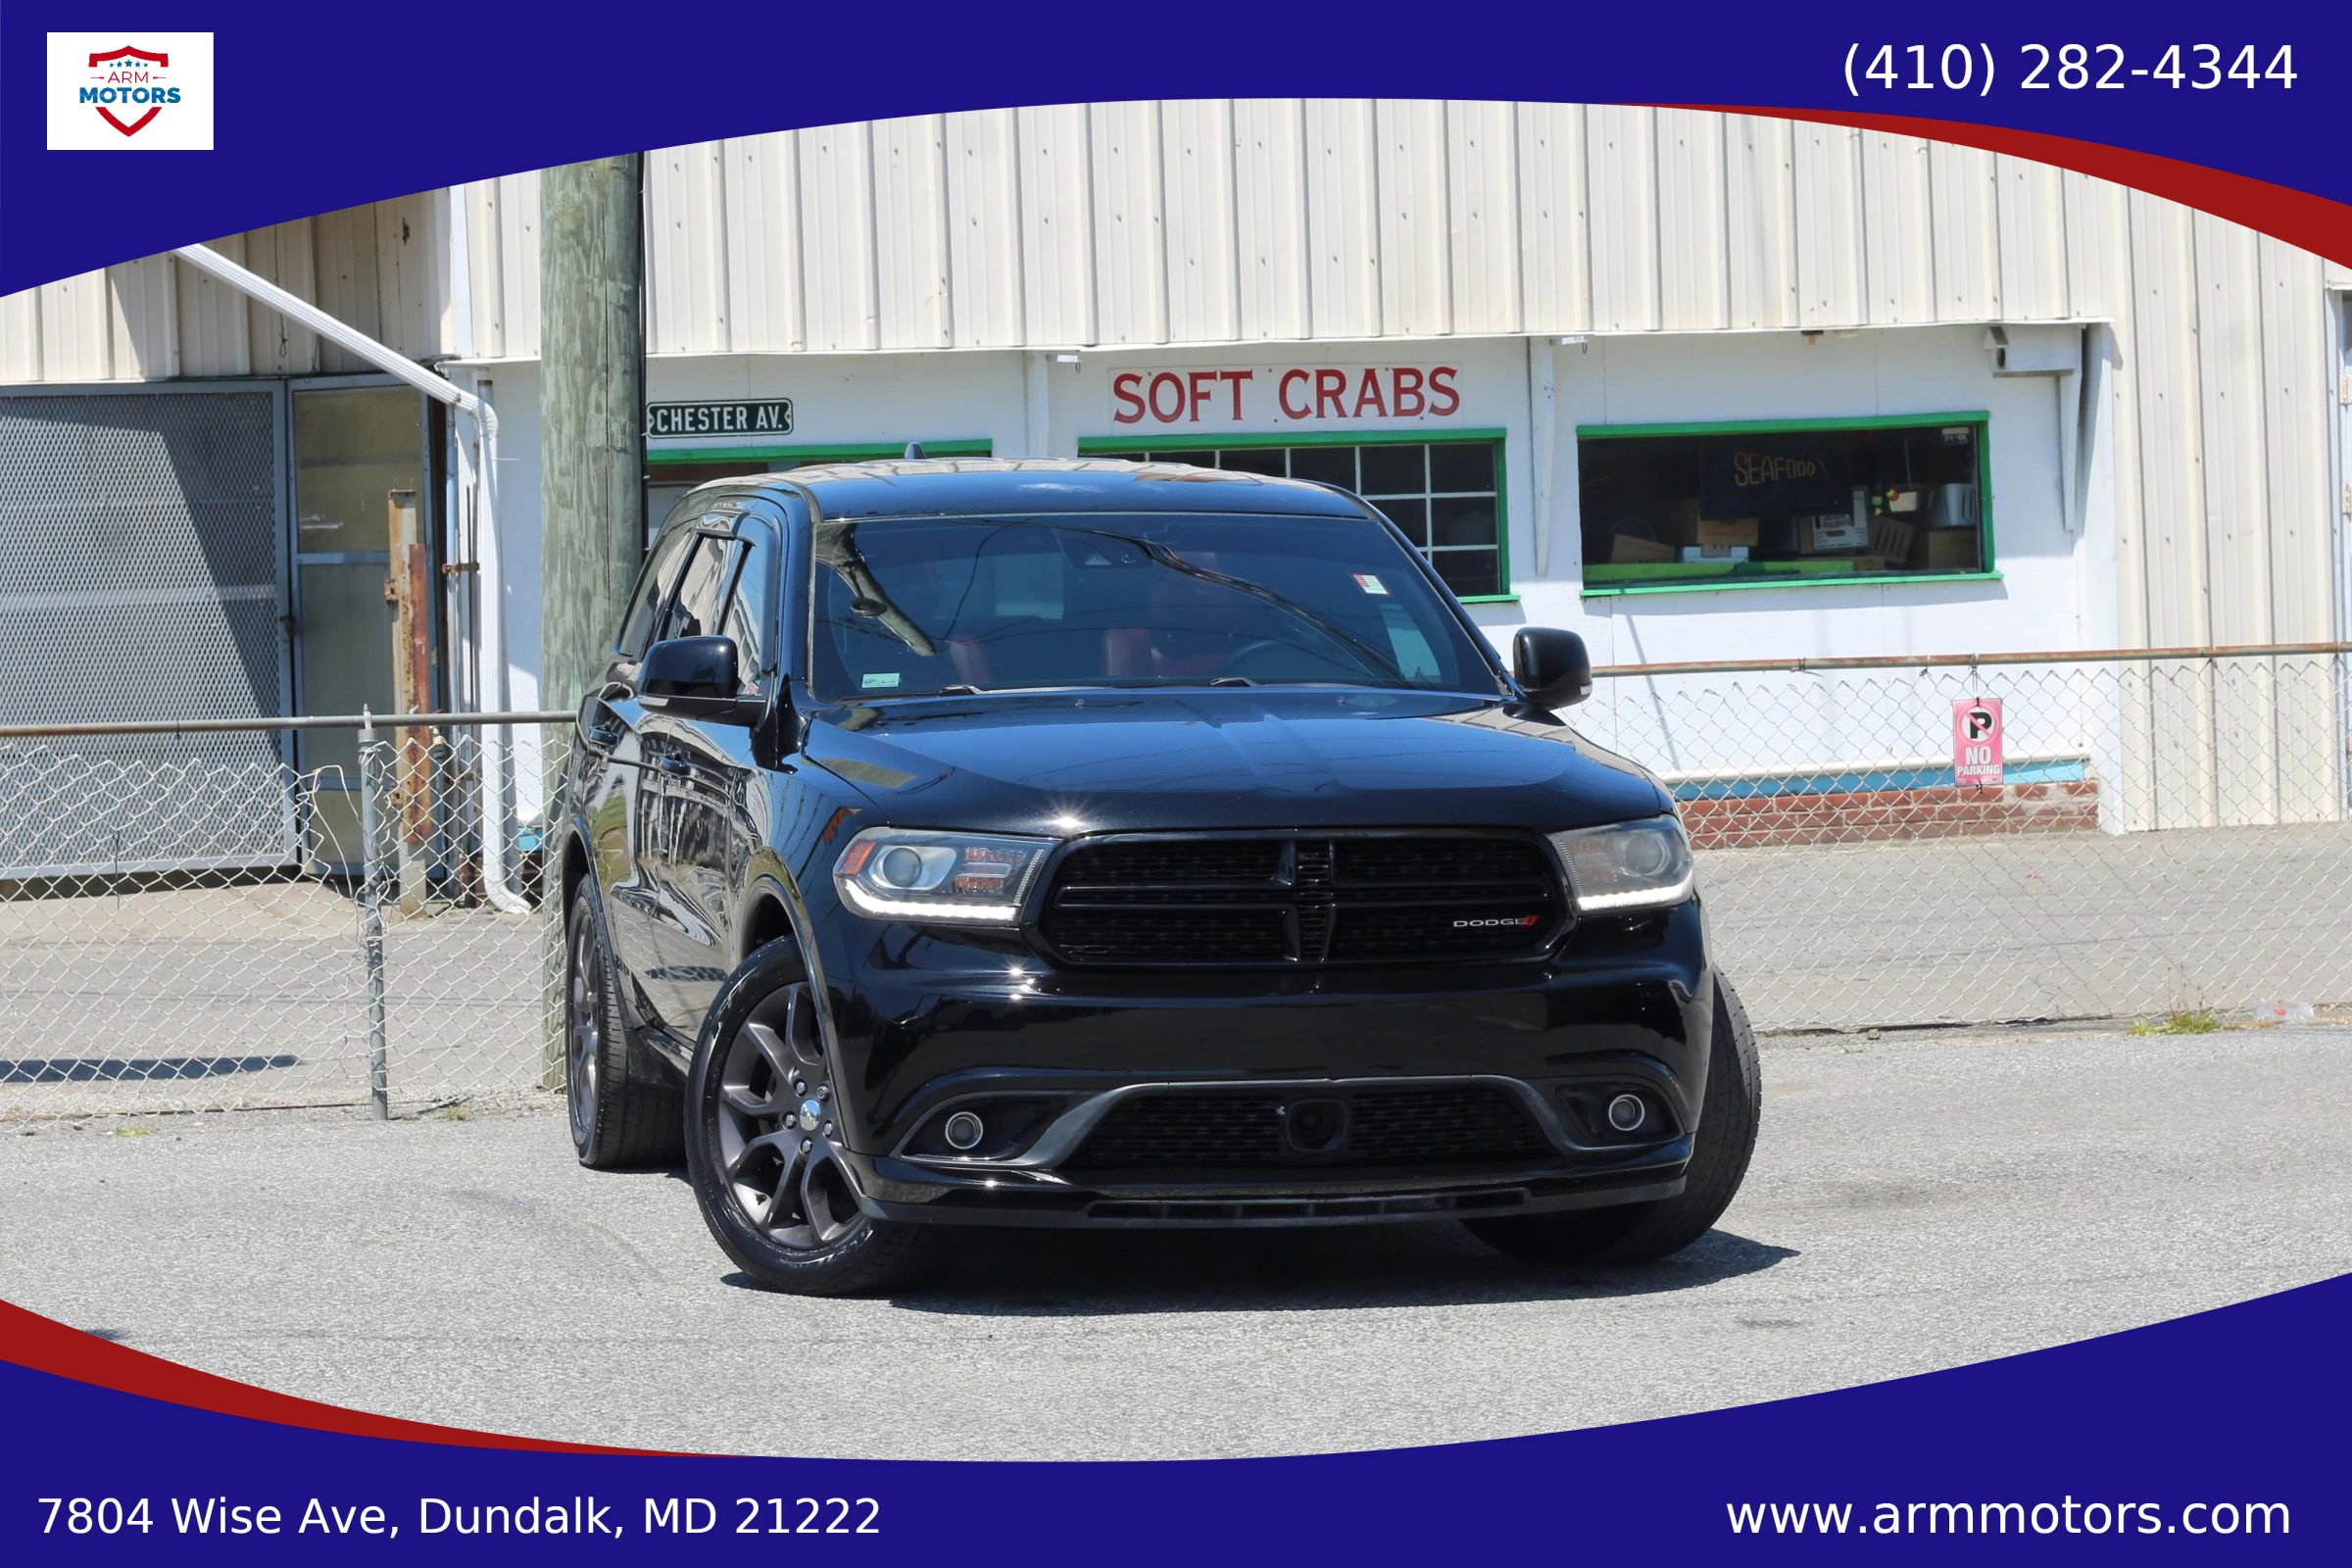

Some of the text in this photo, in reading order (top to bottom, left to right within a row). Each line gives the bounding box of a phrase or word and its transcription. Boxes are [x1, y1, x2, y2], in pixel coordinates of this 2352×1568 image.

[1113, 366, 1460, 424] SOFT CRABS
[656, 405, 783, 433] CHESTER AV.
[1734, 452, 1816, 487] SEAFOOD
[1966, 747, 1991, 764] NO
[1958, 765, 2000, 776] PARKING
[1452, 917, 1529, 928] DODGE
